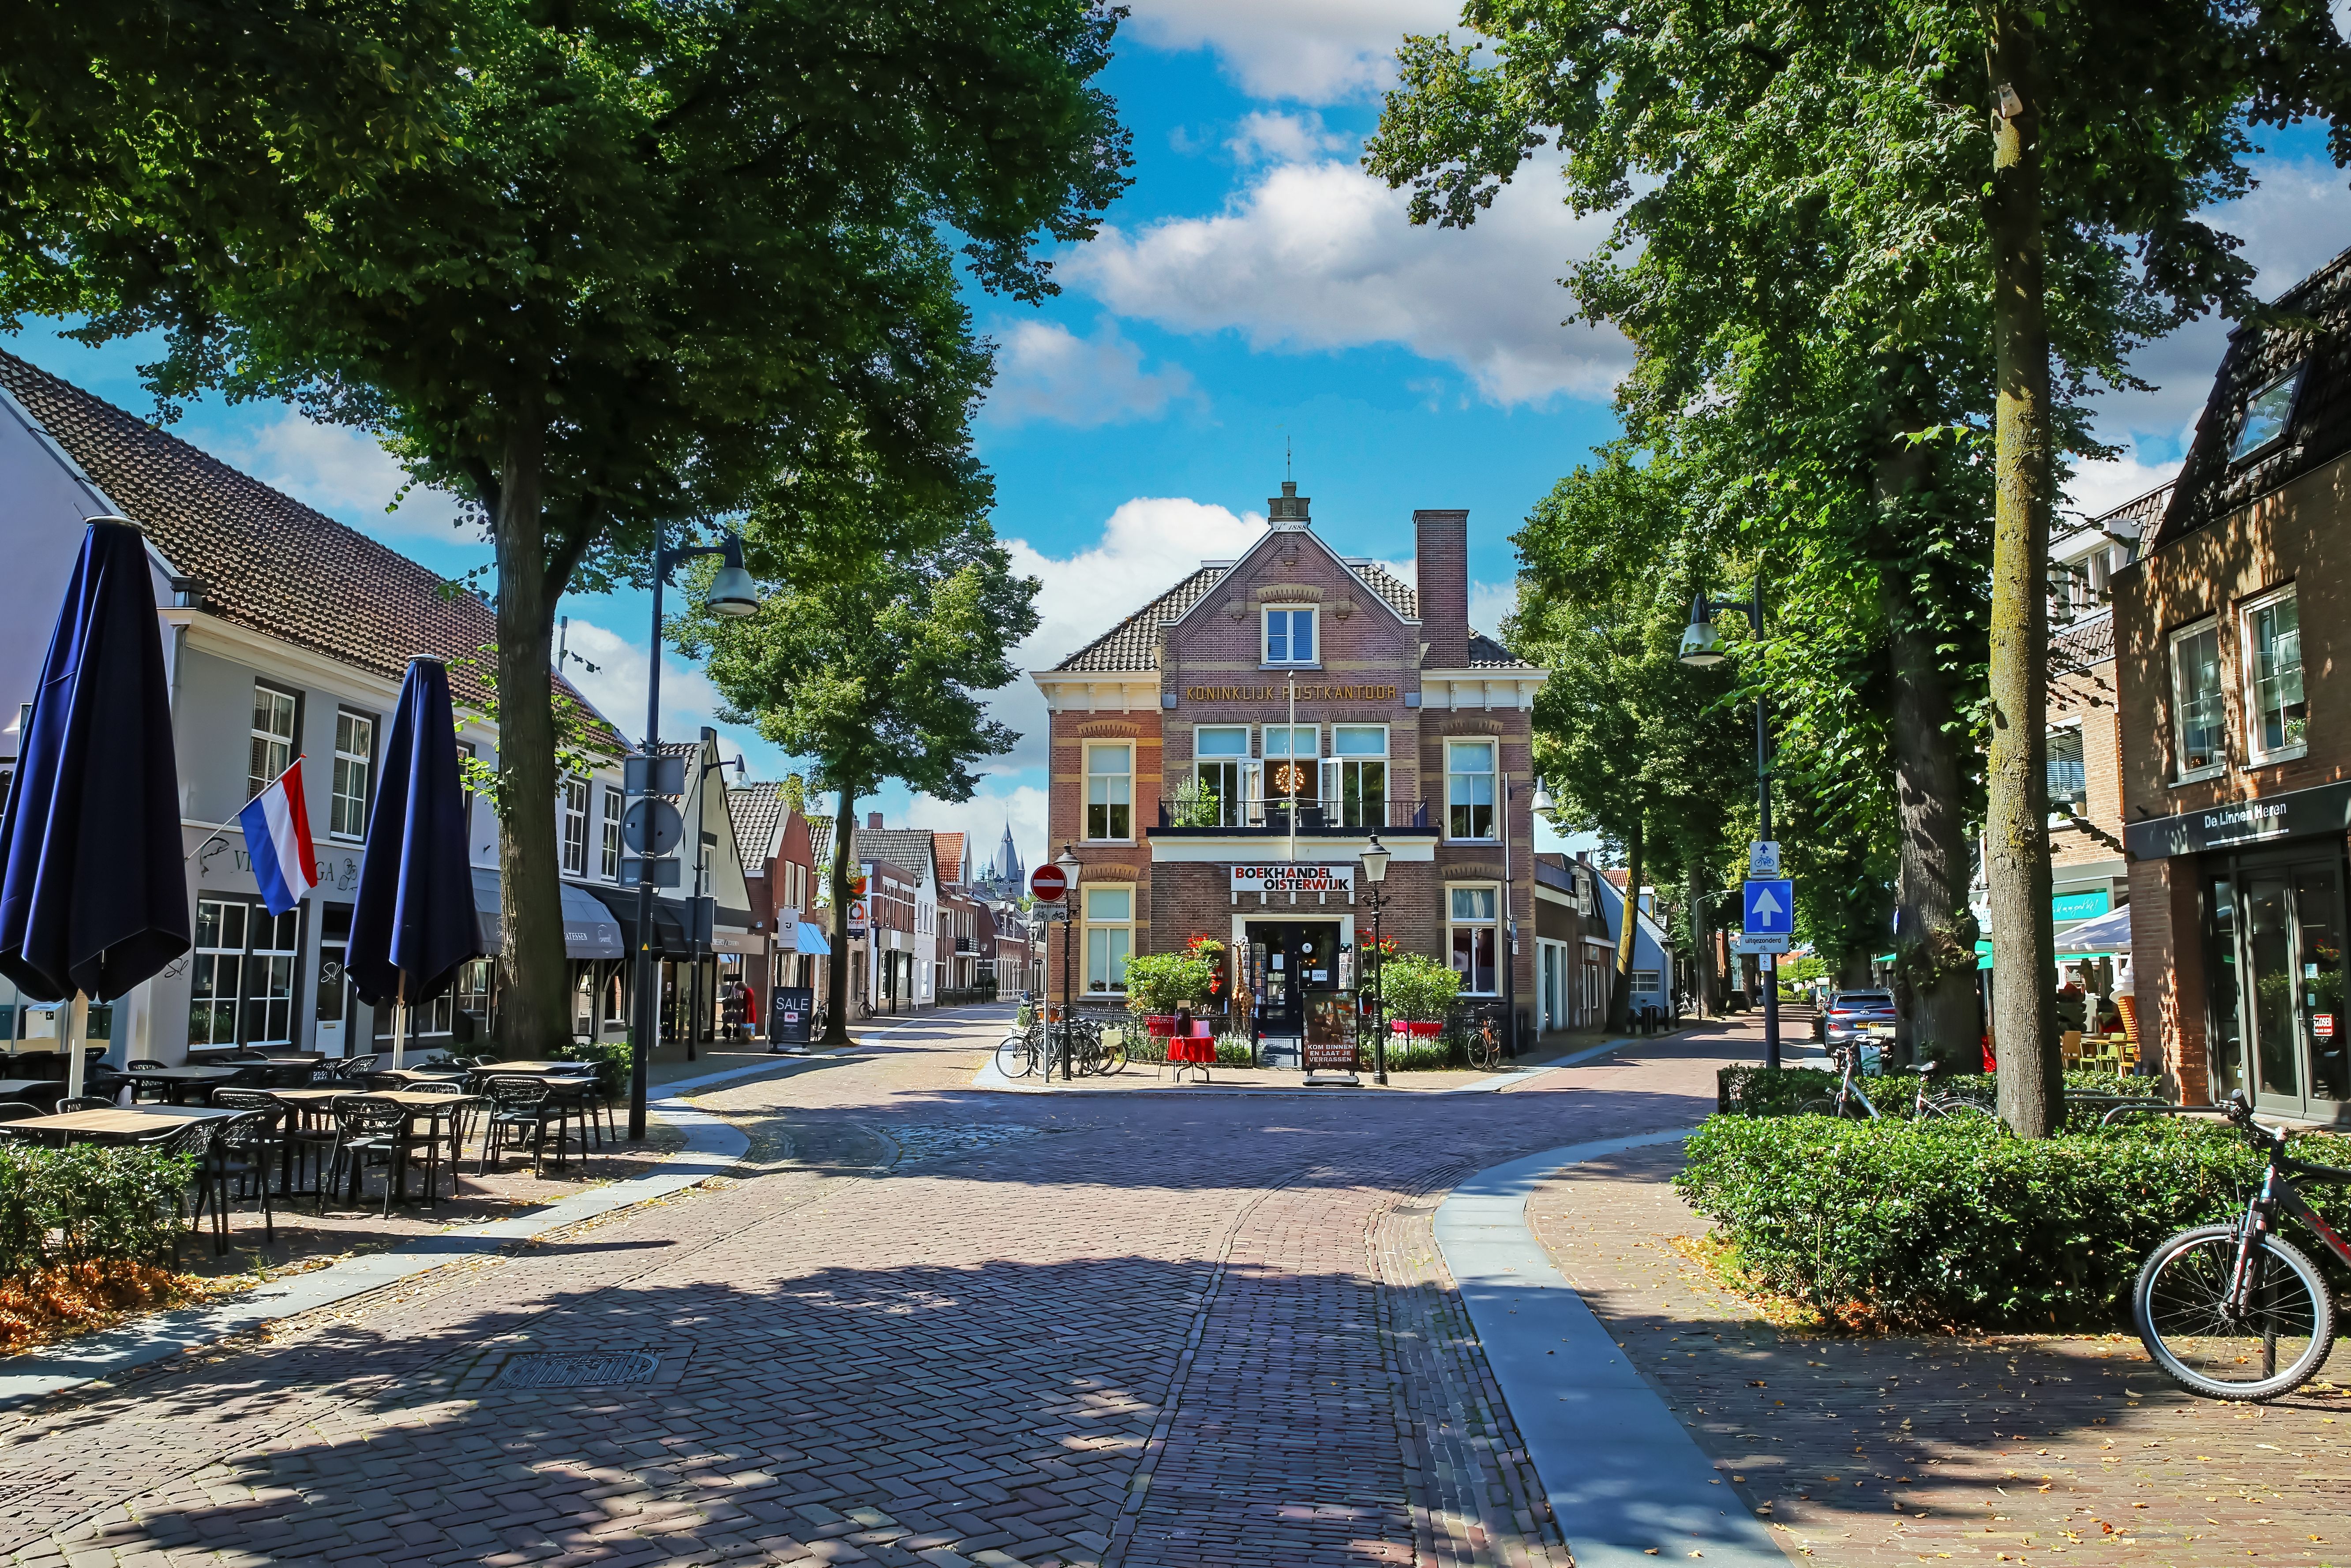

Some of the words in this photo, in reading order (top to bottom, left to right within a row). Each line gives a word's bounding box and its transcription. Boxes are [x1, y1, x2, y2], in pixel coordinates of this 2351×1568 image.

[1186, 686, 1274, 700] KONINKLIJK
[1282, 685, 1396, 700] POSTKANTOOR
[2205, 815, 2217, 828] De
[2220, 809, 2253, 825] Linnen
[2254, 803, 2286, 819] Heren
[1235, 867, 1333, 879] BOEKHANDEL
[1264, 879, 1349, 890] OISTERWIJK
[776, 997, 809, 1010] SALE
